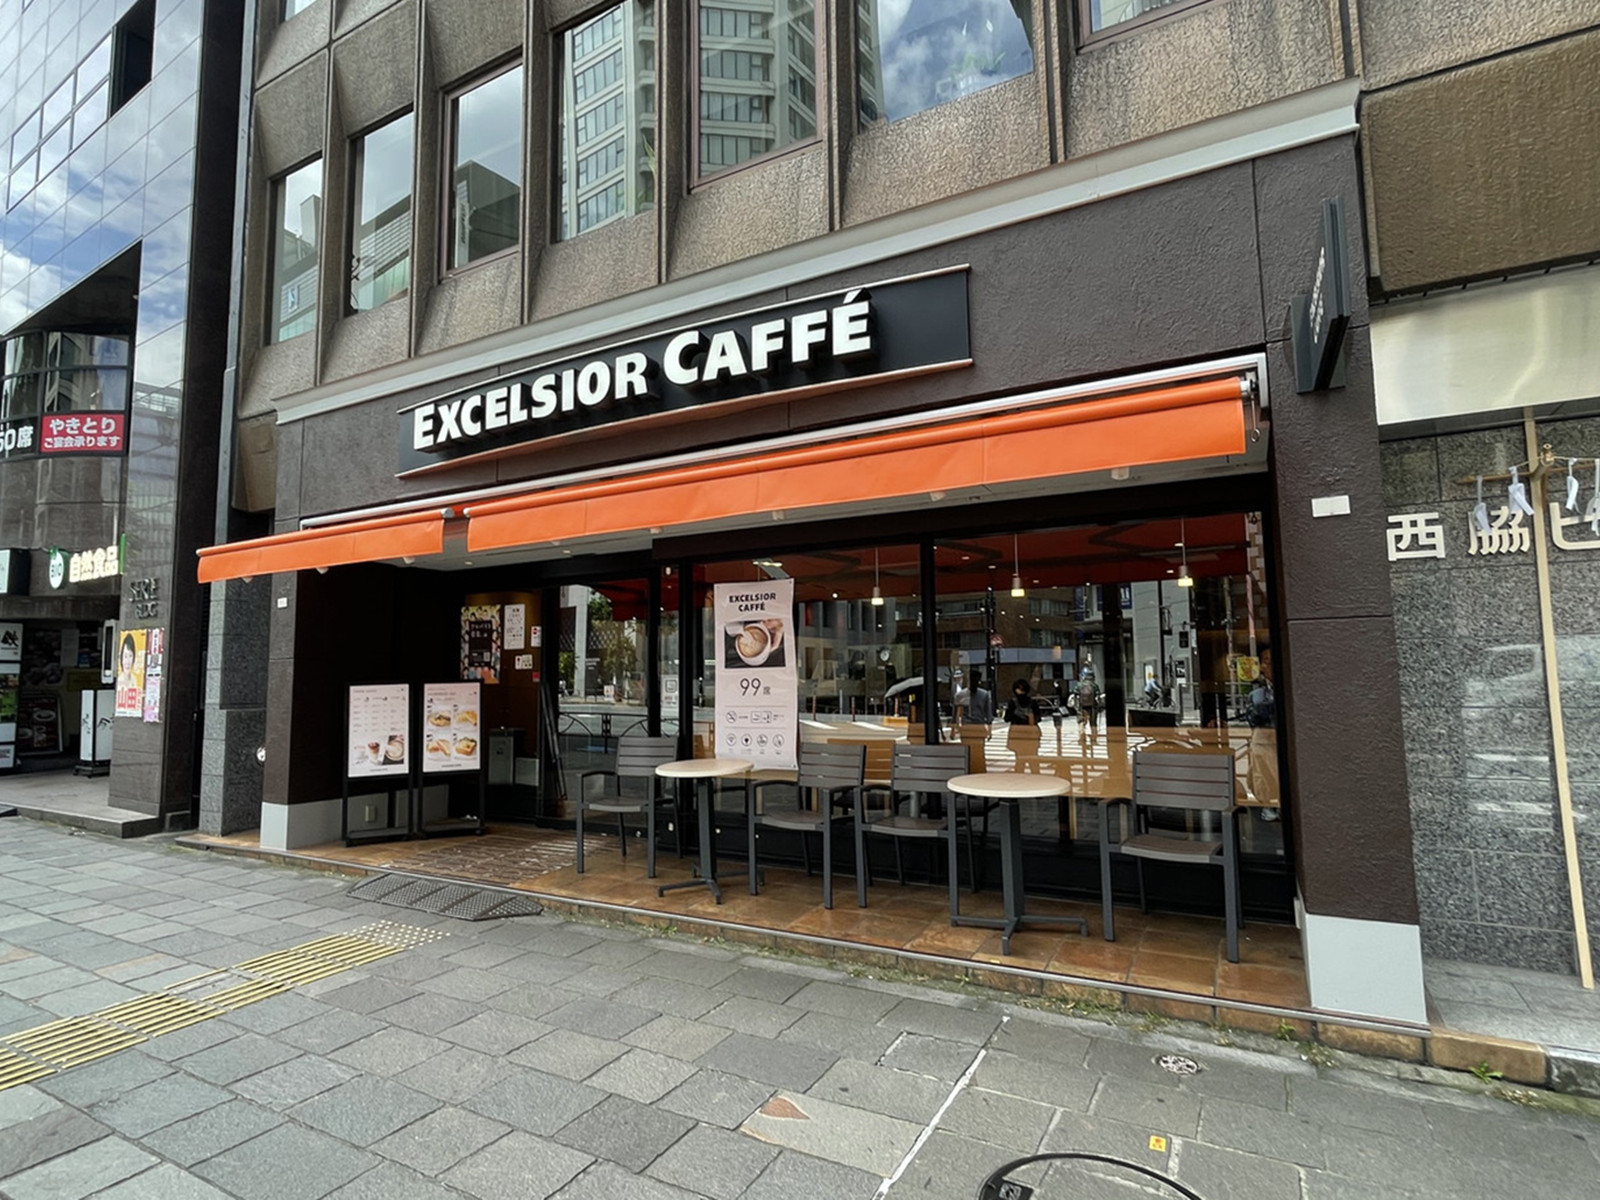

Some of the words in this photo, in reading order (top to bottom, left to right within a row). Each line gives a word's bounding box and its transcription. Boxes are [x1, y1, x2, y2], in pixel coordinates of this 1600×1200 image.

[413, 352, 648, 450] EXCELSIOR
[663, 287, 871, 385] CAFFÉ
[49, 417, 116, 435] やきとり
[44, 436, 120, 448] ご宴会承ります
[729, 592, 777, 603] EXCELSIOR
[738, 602, 766, 612] CAFFÉ
